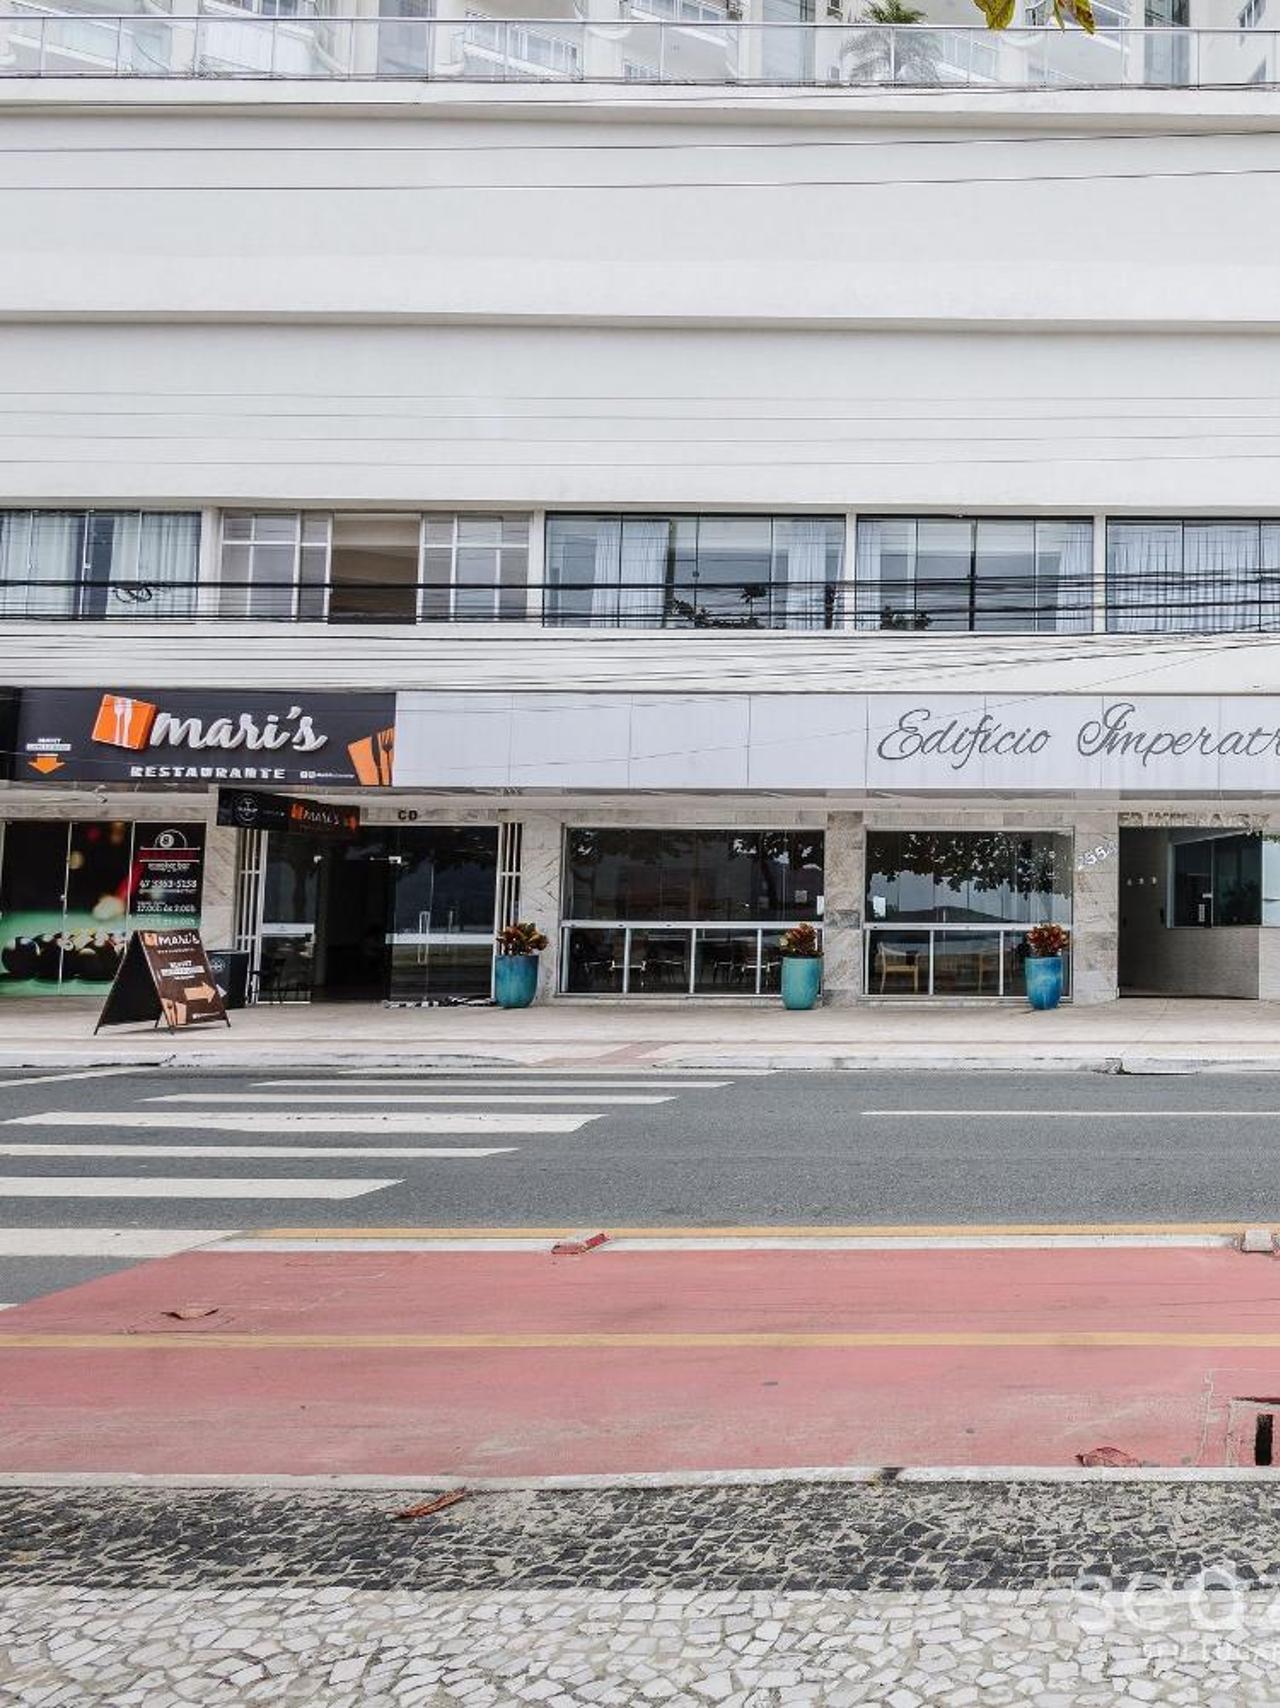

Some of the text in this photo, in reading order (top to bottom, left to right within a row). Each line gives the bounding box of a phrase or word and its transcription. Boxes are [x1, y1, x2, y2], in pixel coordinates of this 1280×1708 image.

[150, 705, 328, 752] mari's
[877, 708, 1052, 770] Edifício
[130, 765, 286, 780] RESTAURANTE
